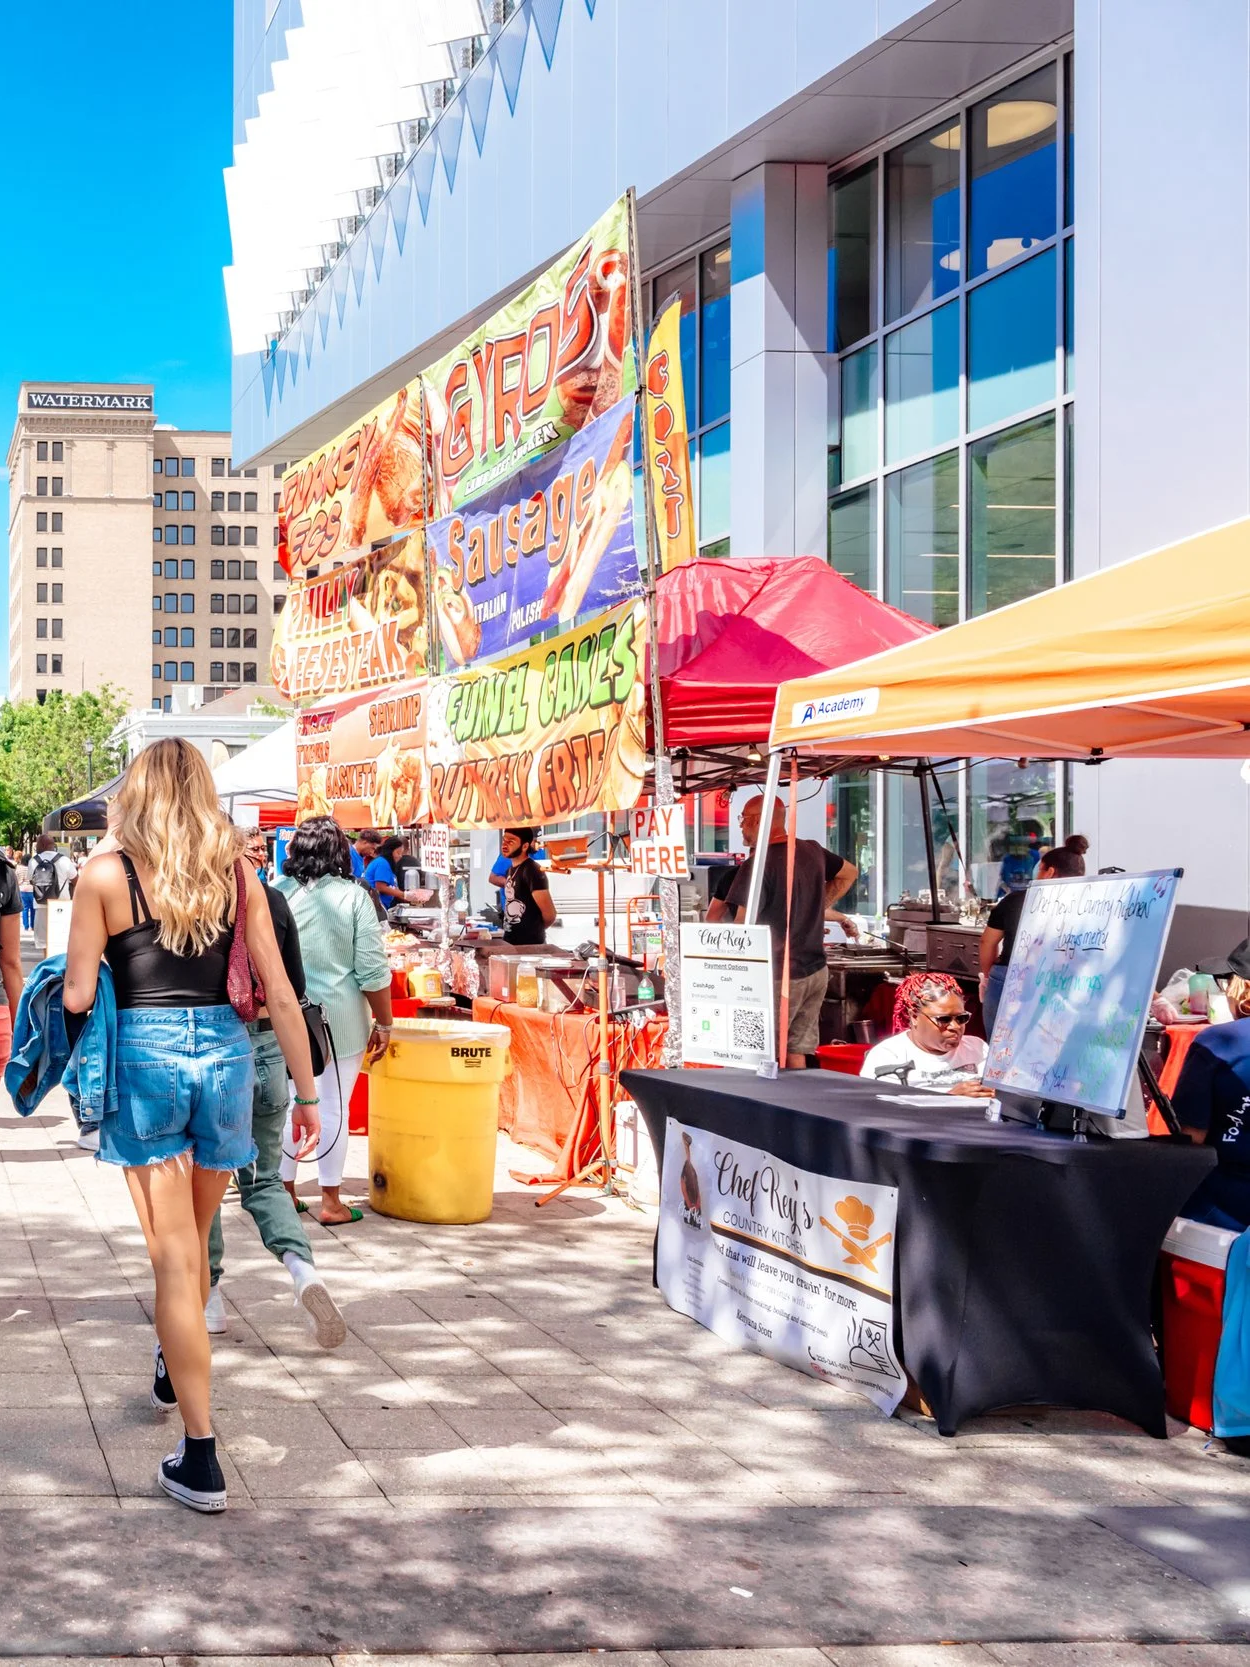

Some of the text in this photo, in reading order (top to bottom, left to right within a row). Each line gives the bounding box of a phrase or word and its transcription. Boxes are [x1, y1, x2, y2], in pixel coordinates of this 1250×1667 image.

[441, 240, 598, 481] GYROS
[30, 394, 150, 408] WATERMARK
[283, 416, 378, 521] TURKEY
[447, 456, 597, 595] Sausage
[288, 567, 359, 638] PHILLY
[474, 591, 543, 633] ITALIAN POLISH
[538, 612, 637, 728] CAKES
[369, 692, 421, 738] SHRIMP
[817, 695, 866, 715] Academy
[325, 761, 377, 799] BASKETS
[422, 829, 447, 848] ORDER
[635, 808, 673, 837] PAY
[425, 850, 446, 869] HERE
[632, 846, 687, 874] HERE
[698, 929, 752, 950] Chef Key's
[704, 962, 748, 972] Payment Options
[692, 982, 715, 990] CashApp
[451, 1047, 492, 1057] BRUTE
[730, 1052, 742, 1060] You!
[714, 1151, 814, 1236] Chef Key's
[723, 1211, 807, 1257] COUNTRY KITCHEN
[725, 1246, 740, 1261] that
[742, 1254, 757, 1268] will
[757, 1259, 778, 1277] leave
[780, 1269, 795, 1283] you
[824, 1286, 837, 1301] for
[837, 1294, 858, 1311] more.
